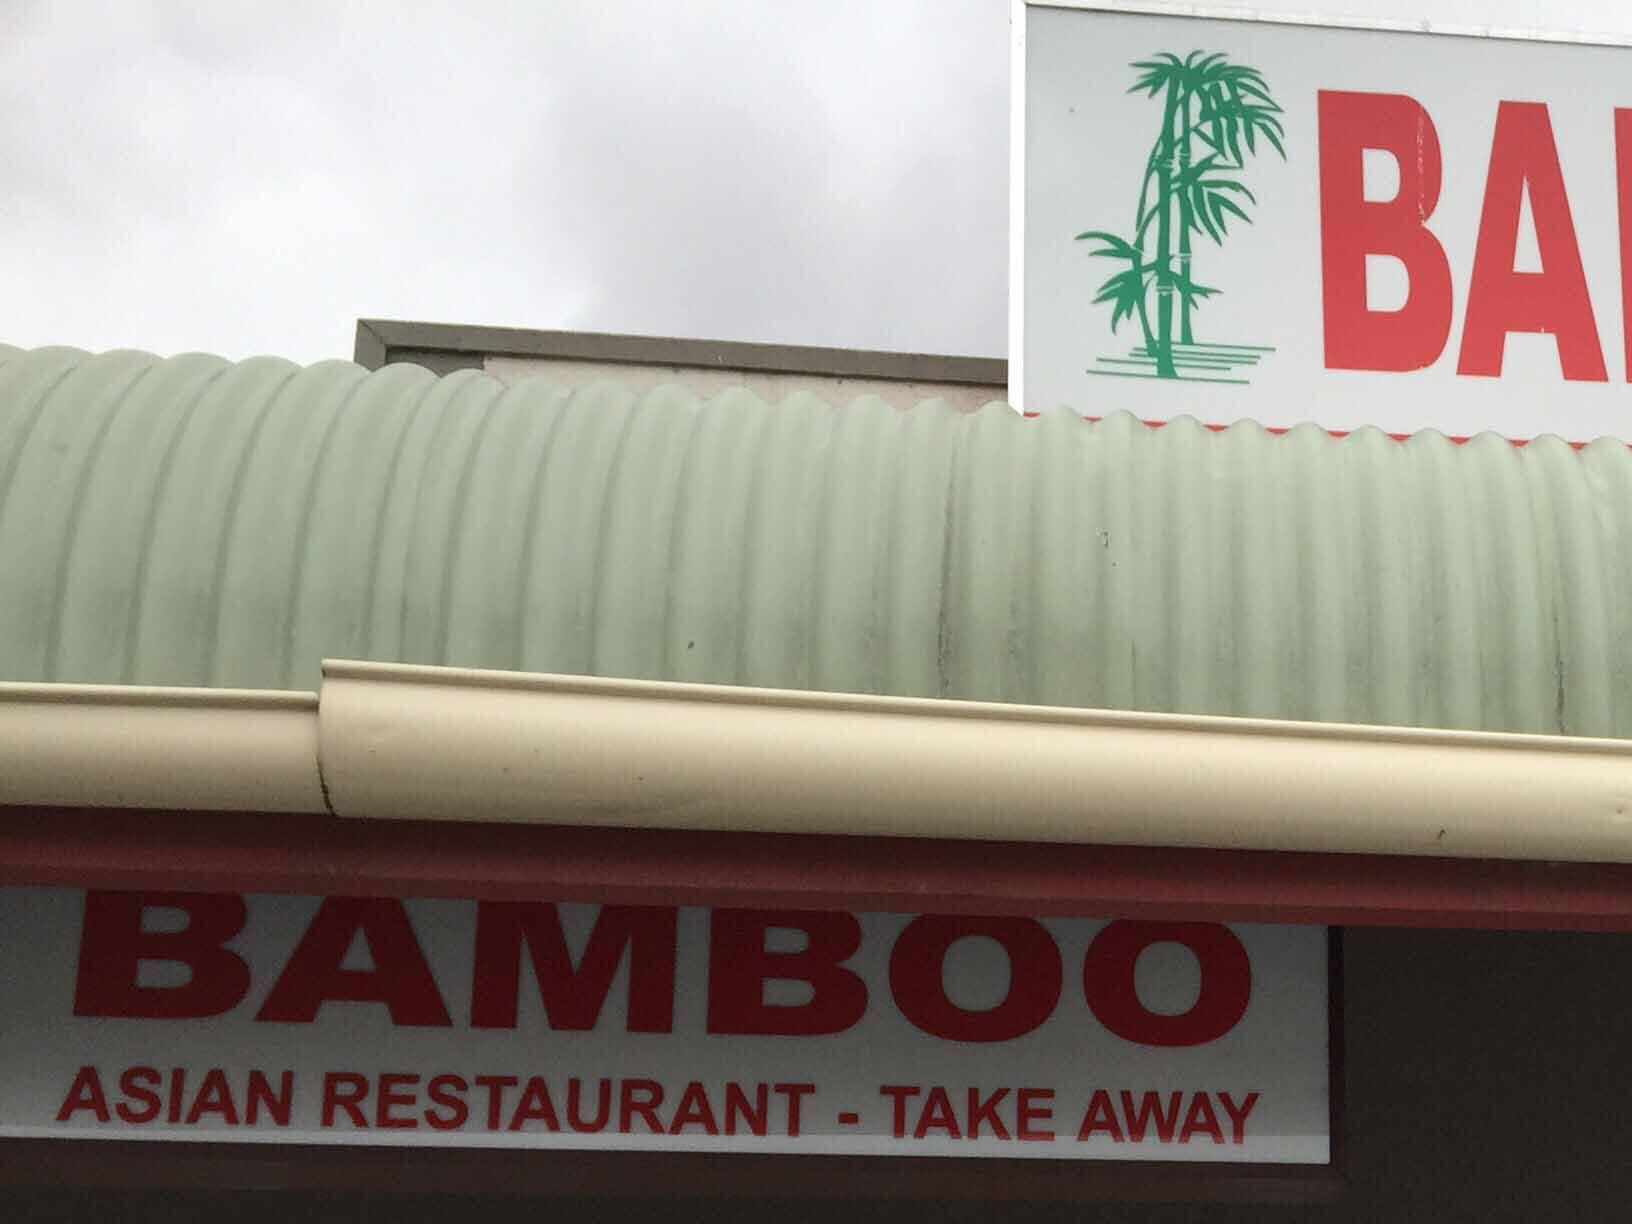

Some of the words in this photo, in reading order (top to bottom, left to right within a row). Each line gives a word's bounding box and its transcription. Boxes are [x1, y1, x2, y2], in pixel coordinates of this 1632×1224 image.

[72, 889, 1253, 1047] BAMBOO
[56, 1065, 293, 1127] ASIAN
[319, 1072, 816, 1138] RESTAURANT
[880, 1084, 1055, 1143] TAKE
[1076, 1089, 1261, 1145] AWAY
